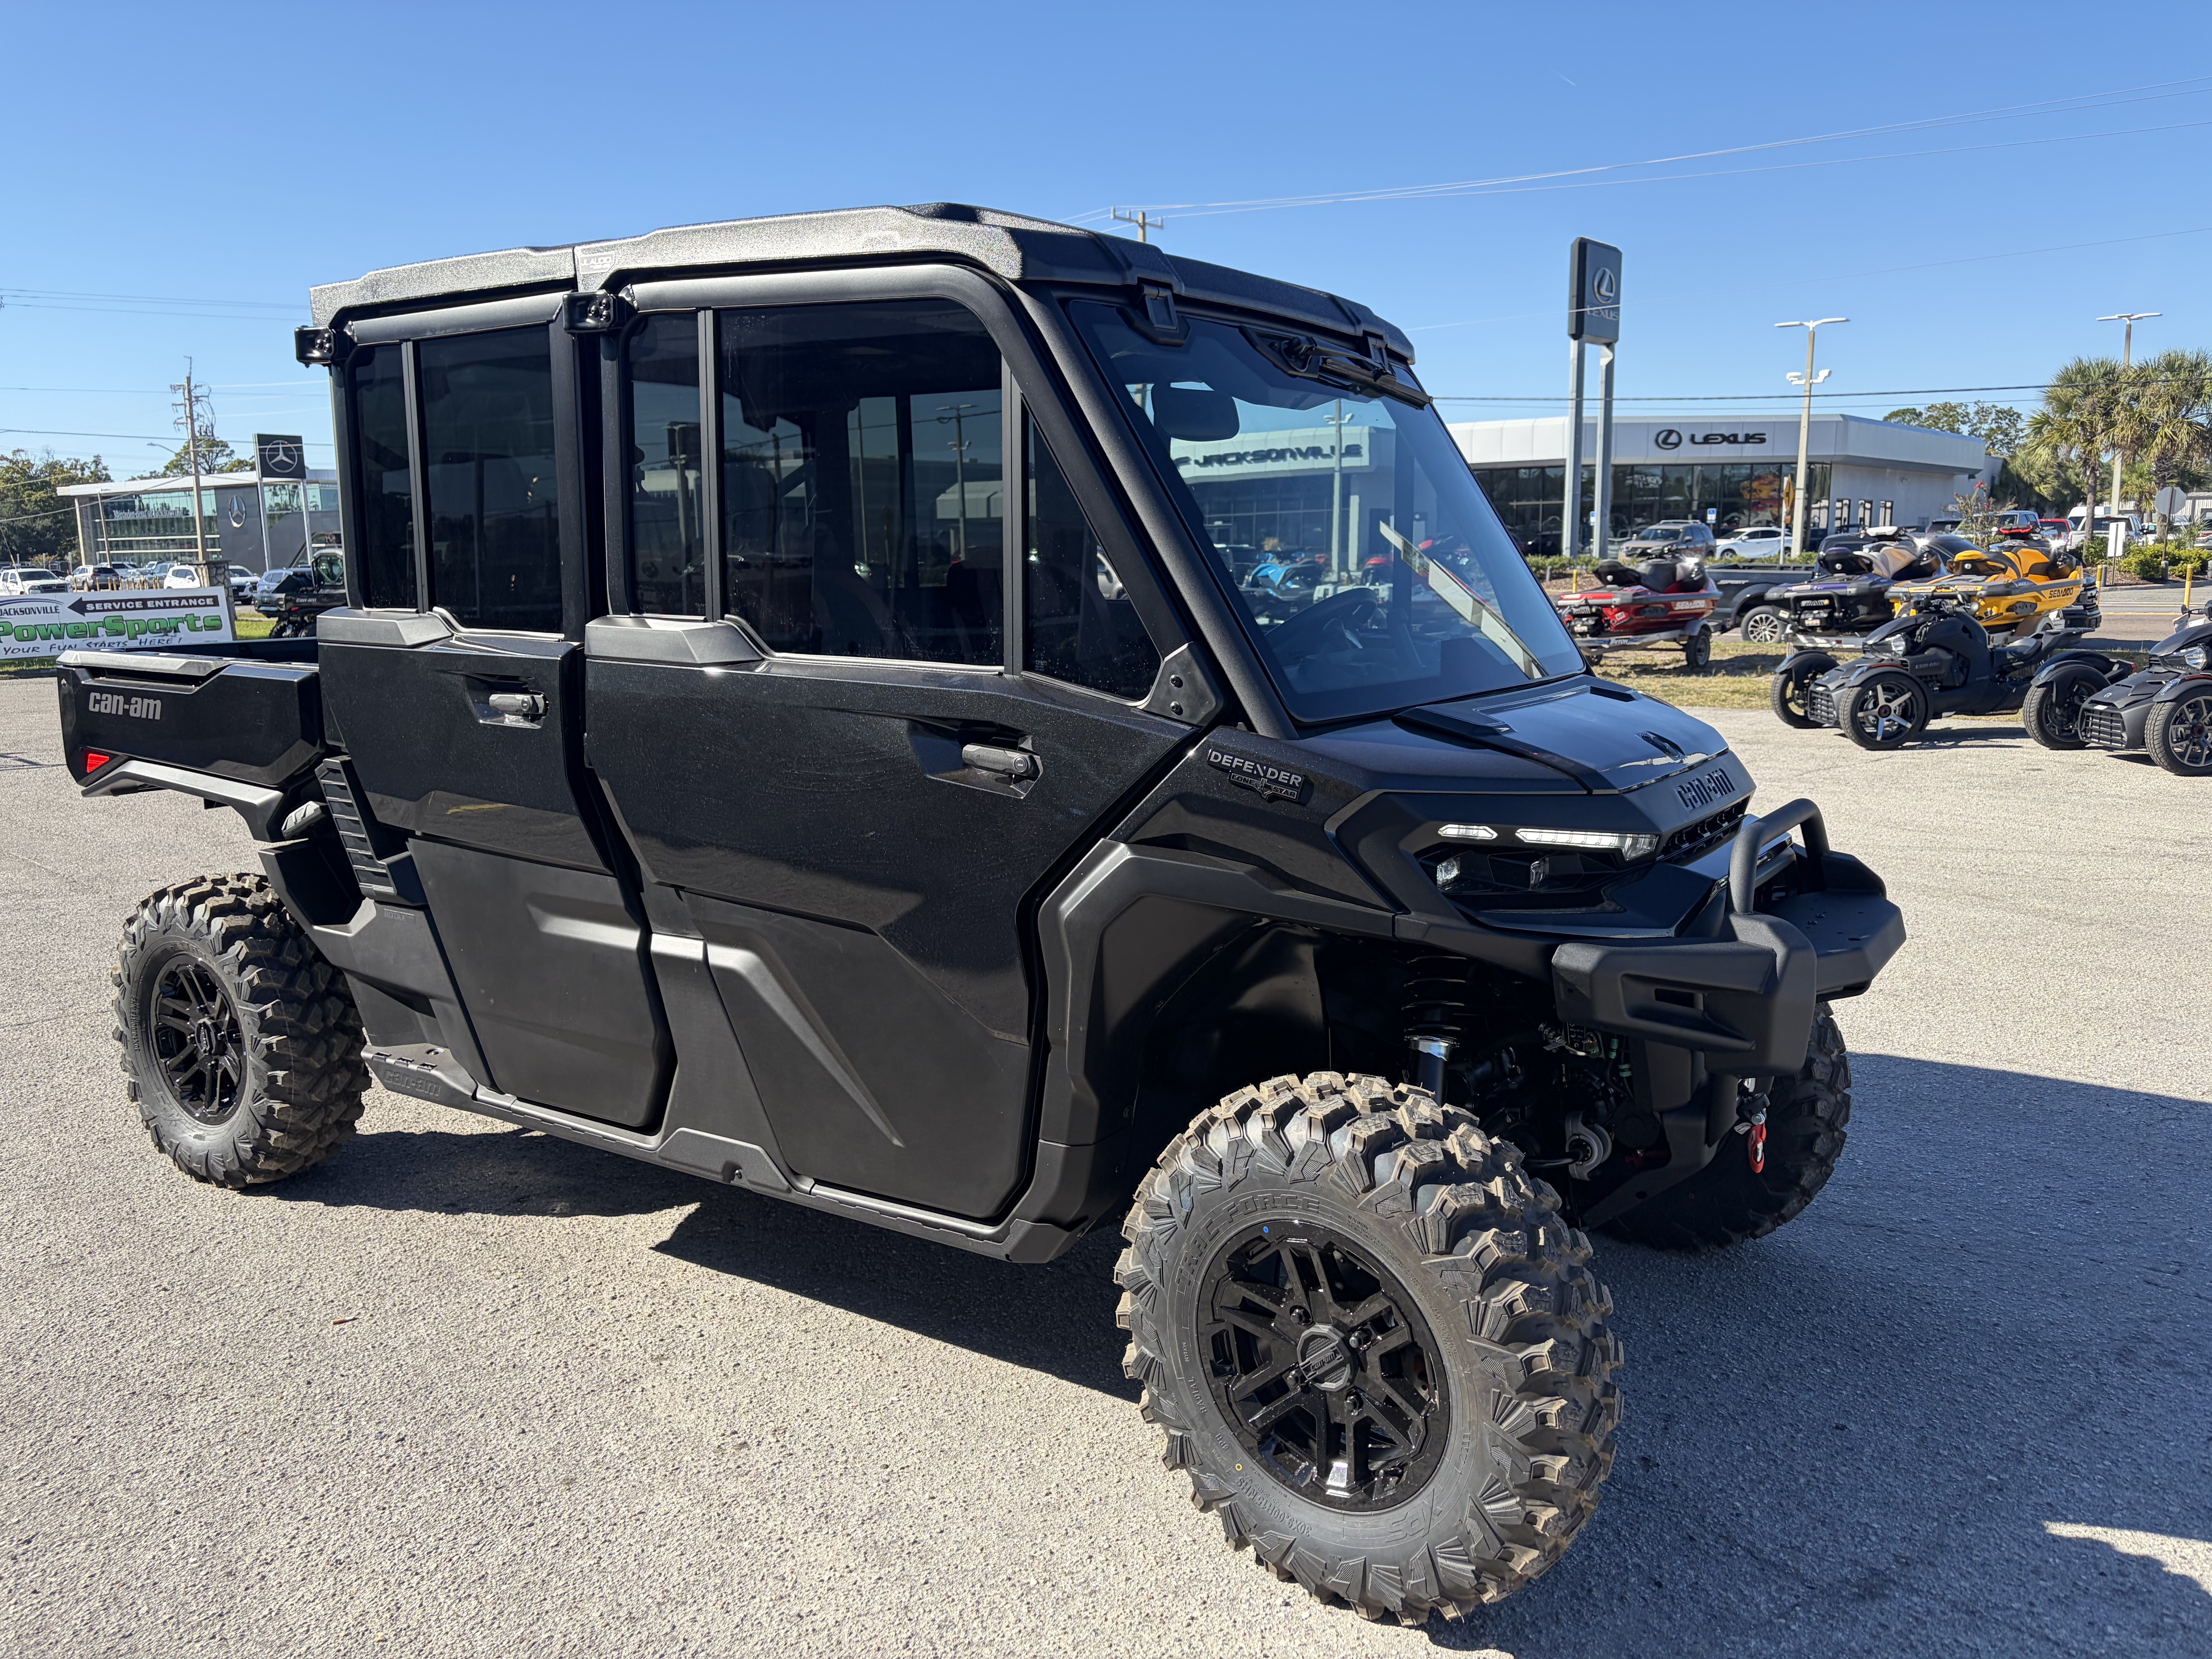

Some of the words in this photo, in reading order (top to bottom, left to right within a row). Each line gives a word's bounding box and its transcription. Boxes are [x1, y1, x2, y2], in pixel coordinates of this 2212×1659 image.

[1587, 305, 1619, 321] LEXUS
[1690, 433, 1767, 445] LEXUS
[1194, 444, 1364, 468] JACKSONVILLE
[0, 606, 60, 617] JACKSONVILLE
[86, 601, 143, 611] SERVICE
[147, 598, 214, 608] ENTRANCE
[0, 613, 223, 643] PowerSports
[3, 646, 40, 655] YOUR
[49, 644, 77, 653] FUN
[86, 640, 128, 648] STARTS
[89, 692, 162, 720] can-am
[1209, 750, 1302, 787] DEFENDER
[1232, 775, 1257, 786] LONE
[1273, 786, 1296, 798] STAR
[1674, 768, 1736, 812] can-am
[384, 910, 405, 922] ROTAX
[383, 1069, 441, 1097] can-am
[1175, 1218, 1219, 1286] TRAC
[1223, 1194, 1320, 1224] FORCE
[1310, 1351, 1336, 1371] can-am
[1188, 1376, 1207, 1413] RADIAL
[1237, 1477, 1258, 1500] NHS
[1255, 1495, 1312, 1537] 30X9.00R15
